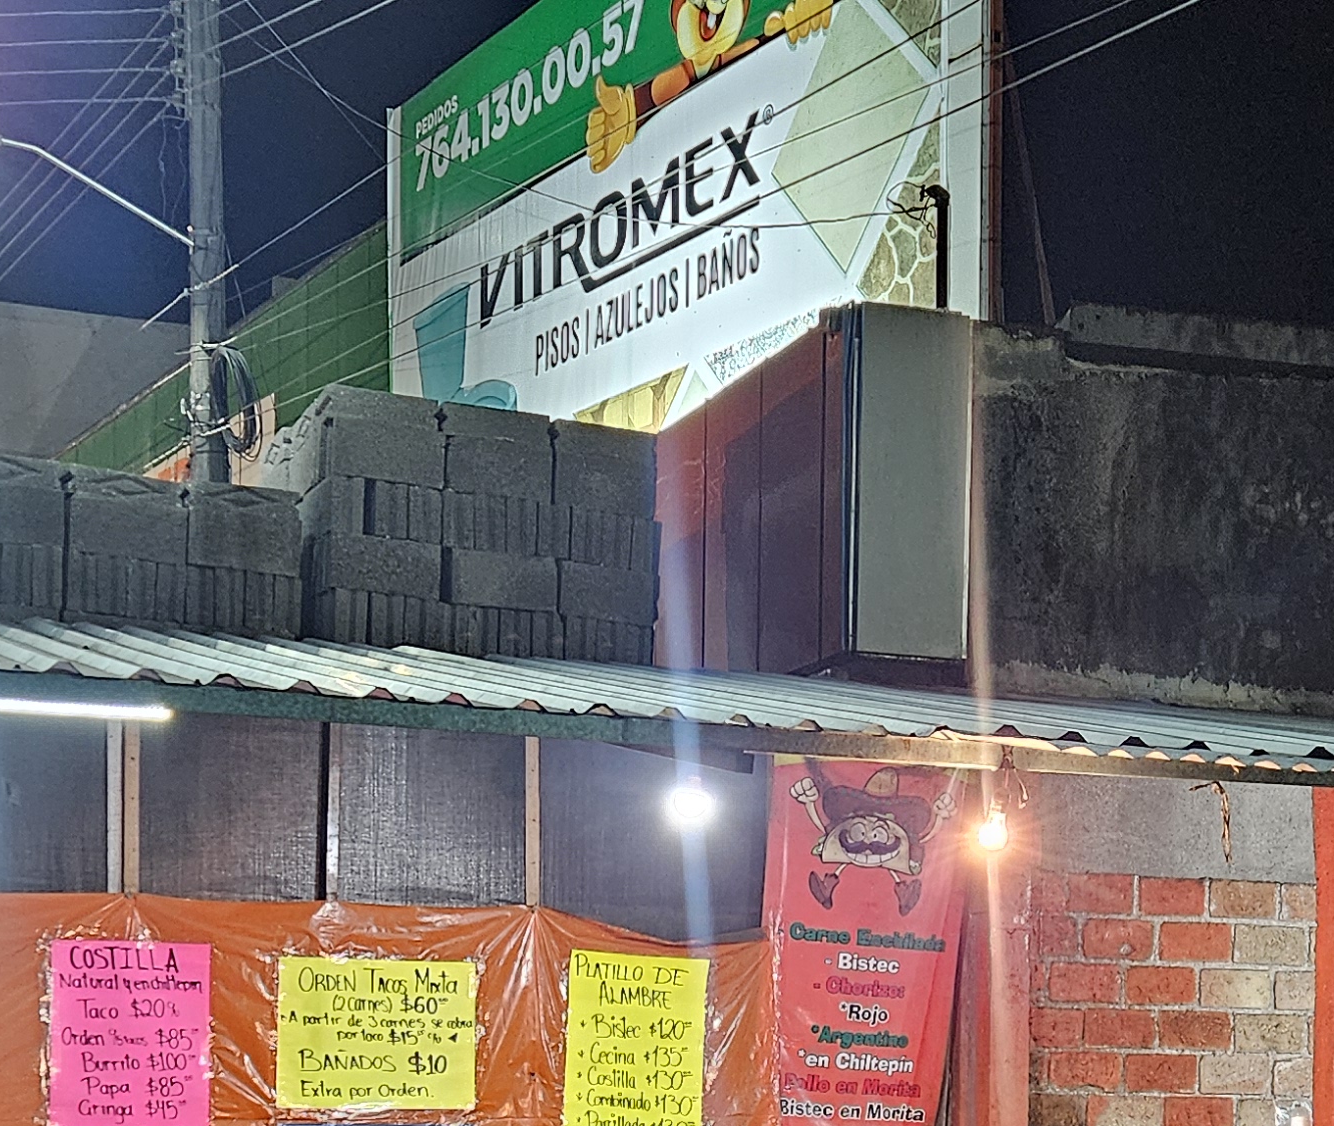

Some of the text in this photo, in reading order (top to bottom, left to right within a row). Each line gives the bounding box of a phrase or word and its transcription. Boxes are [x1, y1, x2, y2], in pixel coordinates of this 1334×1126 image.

[415, 0, 641, 193] 764.130.00.57
[416, 94, 459, 139] PEDIDOS
[480, 109, 761, 329] VITROMEX
[535, 227, 760, 377] PISOS AZULEJOS BAÑOS
[789, 921, 946, 952] Carne Enchilada
[69, 946, 179, 973] COSTILLA
[574, 953, 689, 986] PLATILLO DE
[838, 951, 900, 973] Bistec
[59, 973, 118, 990] Natural
[298, 966, 356, 992] ORDEN
[599, 980, 672, 1009] ALAMBRE
[76, 999, 119, 1019] Taco
[303, 1013, 340, 1027] partir
[347, 1015, 363, 1028] de
[431, 1018, 443, 1029] se
[62, 1026, 105, 1046] Orden
[591, 1013, 641, 1039] Bistec
[82, 1052, 140, 1073] Burrito
[298, 1048, 447, 1075] BAÑADOS $10
[590, 1042, 635, 1065] Cecina
[835, 1051, 914, 1077] Chiltepín
[80, 1076, 131, 1099] Papa
[587, 1065, 637, 1089] Costilla
[784, 1072, 921, 1098] Pollo en Morita
[300, 1080, 342, 1098] Extra
[350, 1085, 371, 1100] por
[586, 1088, 651, 1112] Combinado
[78, 1099, 134, 1124] Gringa
[840, 1105, 861, 1119] en
[866, 1102, 925, 1122] Morita
